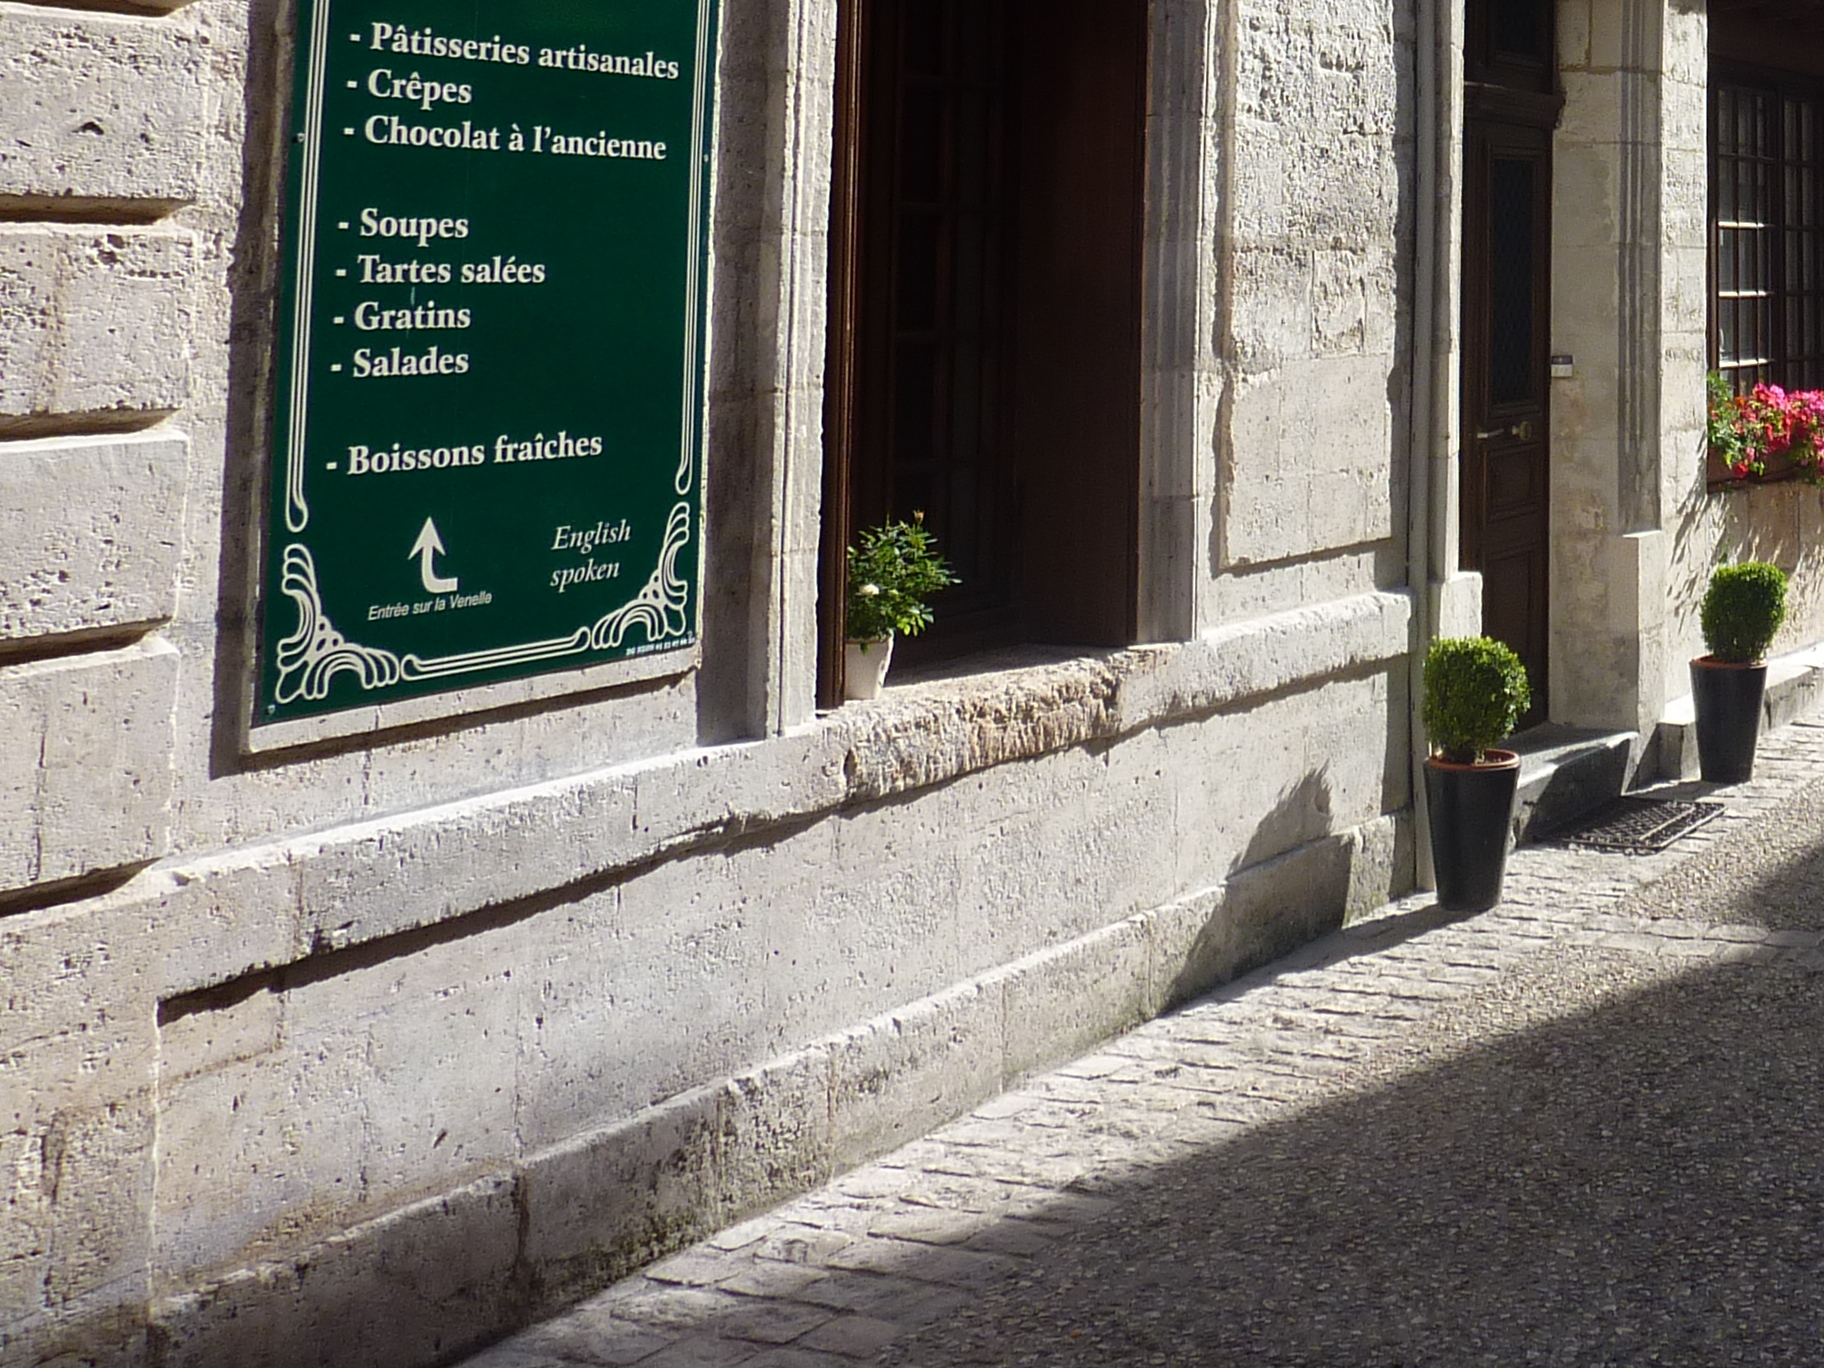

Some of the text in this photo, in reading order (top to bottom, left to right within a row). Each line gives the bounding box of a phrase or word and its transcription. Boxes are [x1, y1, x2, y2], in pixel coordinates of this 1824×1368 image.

[369, 21, 679, 80] Pâtisseries artisanales
[367, 68, 472, 111] Crêpes
[364, 114, 667, 160] Chocolat à l'ancienne
[360, 207, 469, 248] Soupes
[357, 254, 546, 284] Tartes salées
[354, 300, 471, 331] Gratins
[353, 345, 469, 378] Salades
[347, 430, 603, 475] Boissons fraîches
[551, 518, 631, 555] English
[549, 557, 620, 594] spoken
[367, 590, 493, 621] Entrée sur la Venelle
